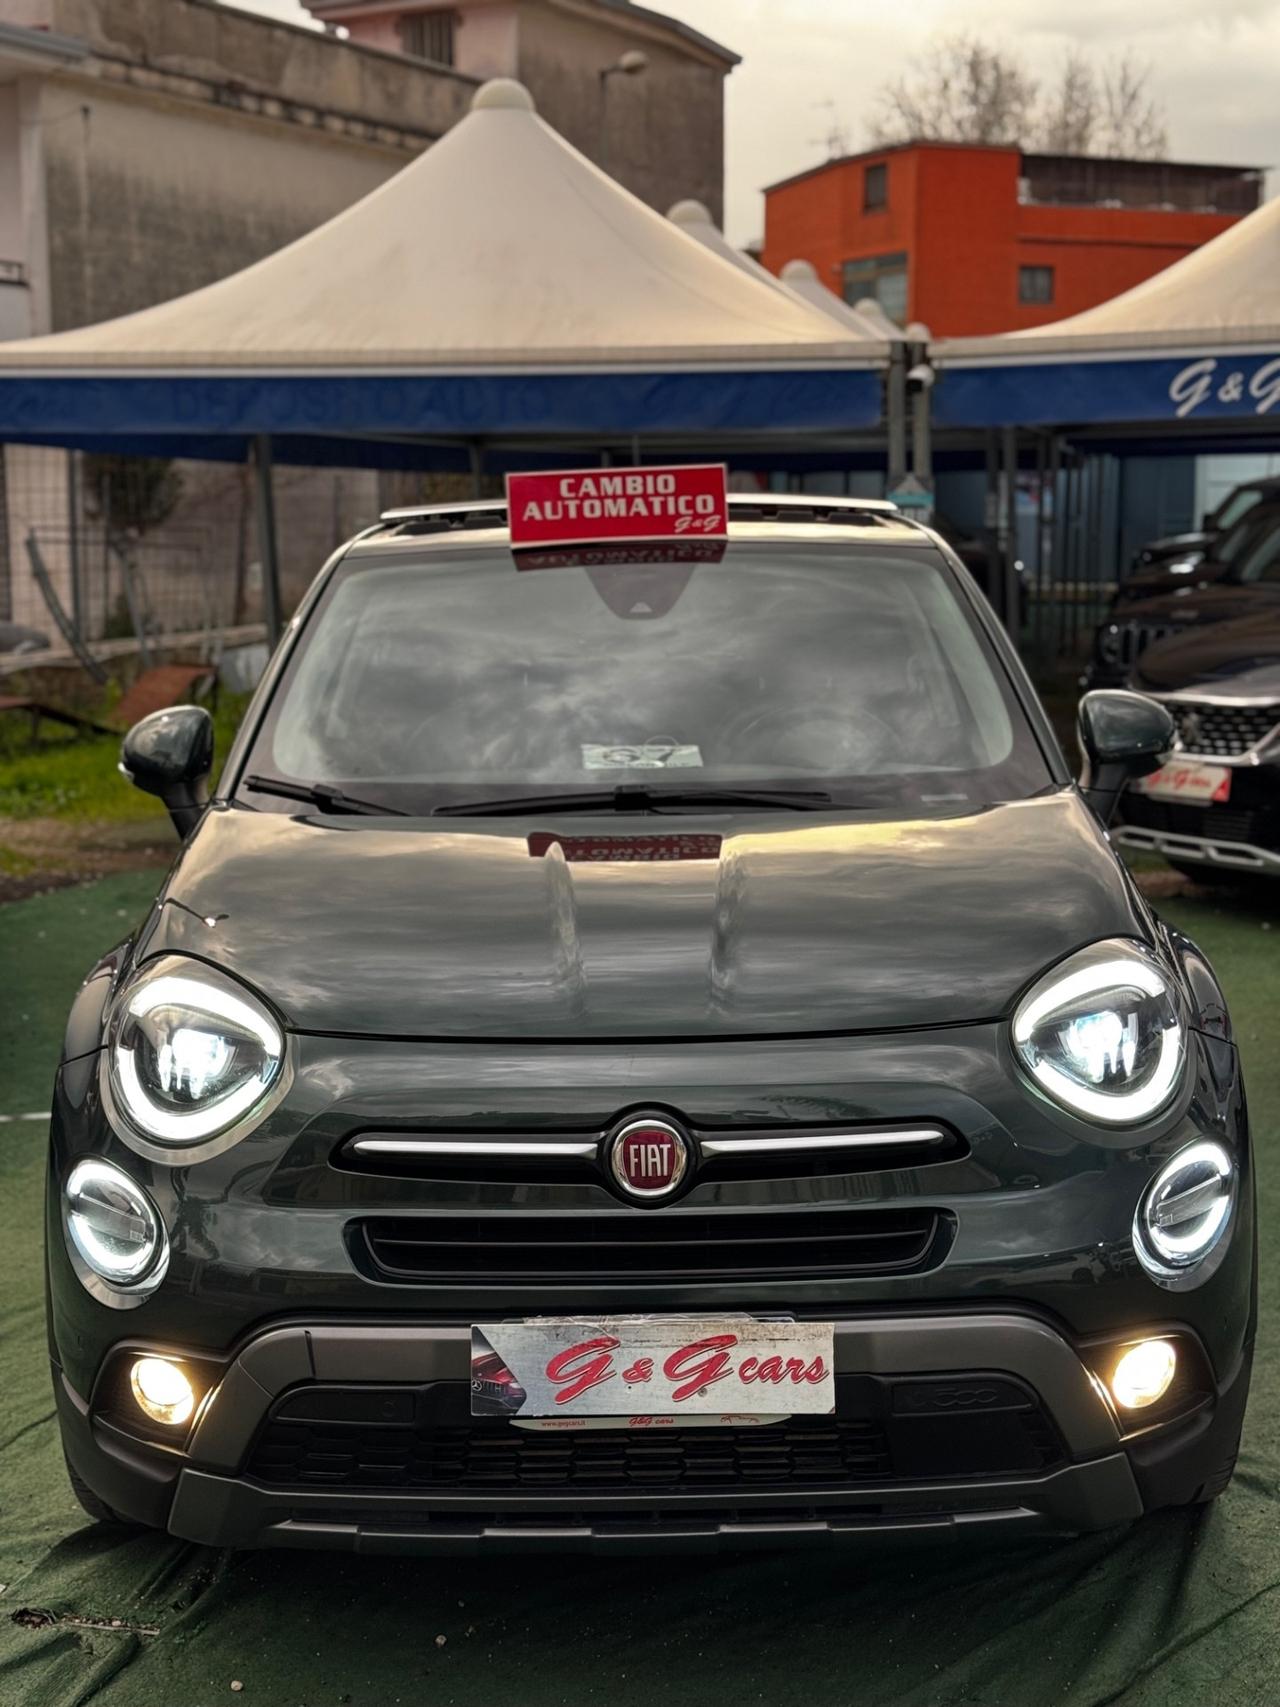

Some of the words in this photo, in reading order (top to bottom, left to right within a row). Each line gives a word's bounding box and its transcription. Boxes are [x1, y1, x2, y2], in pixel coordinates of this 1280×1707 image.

[1169, 359, 1217, 418] G
[1217, 372, 1244, 402] &
[560, 474, 676, 498] CAMBIO
[522, 494, 715, 522] AUTOMATICO
[628, 1143, 672, 1177] FIAT
[545, 1336, 621, 1405] G
[621, 1357, 655, 1384] &
[662, 1334, 738, 1402] G
[738, 1355, 830, 1384] cars
[934, 1387, 998, 1407] 500
